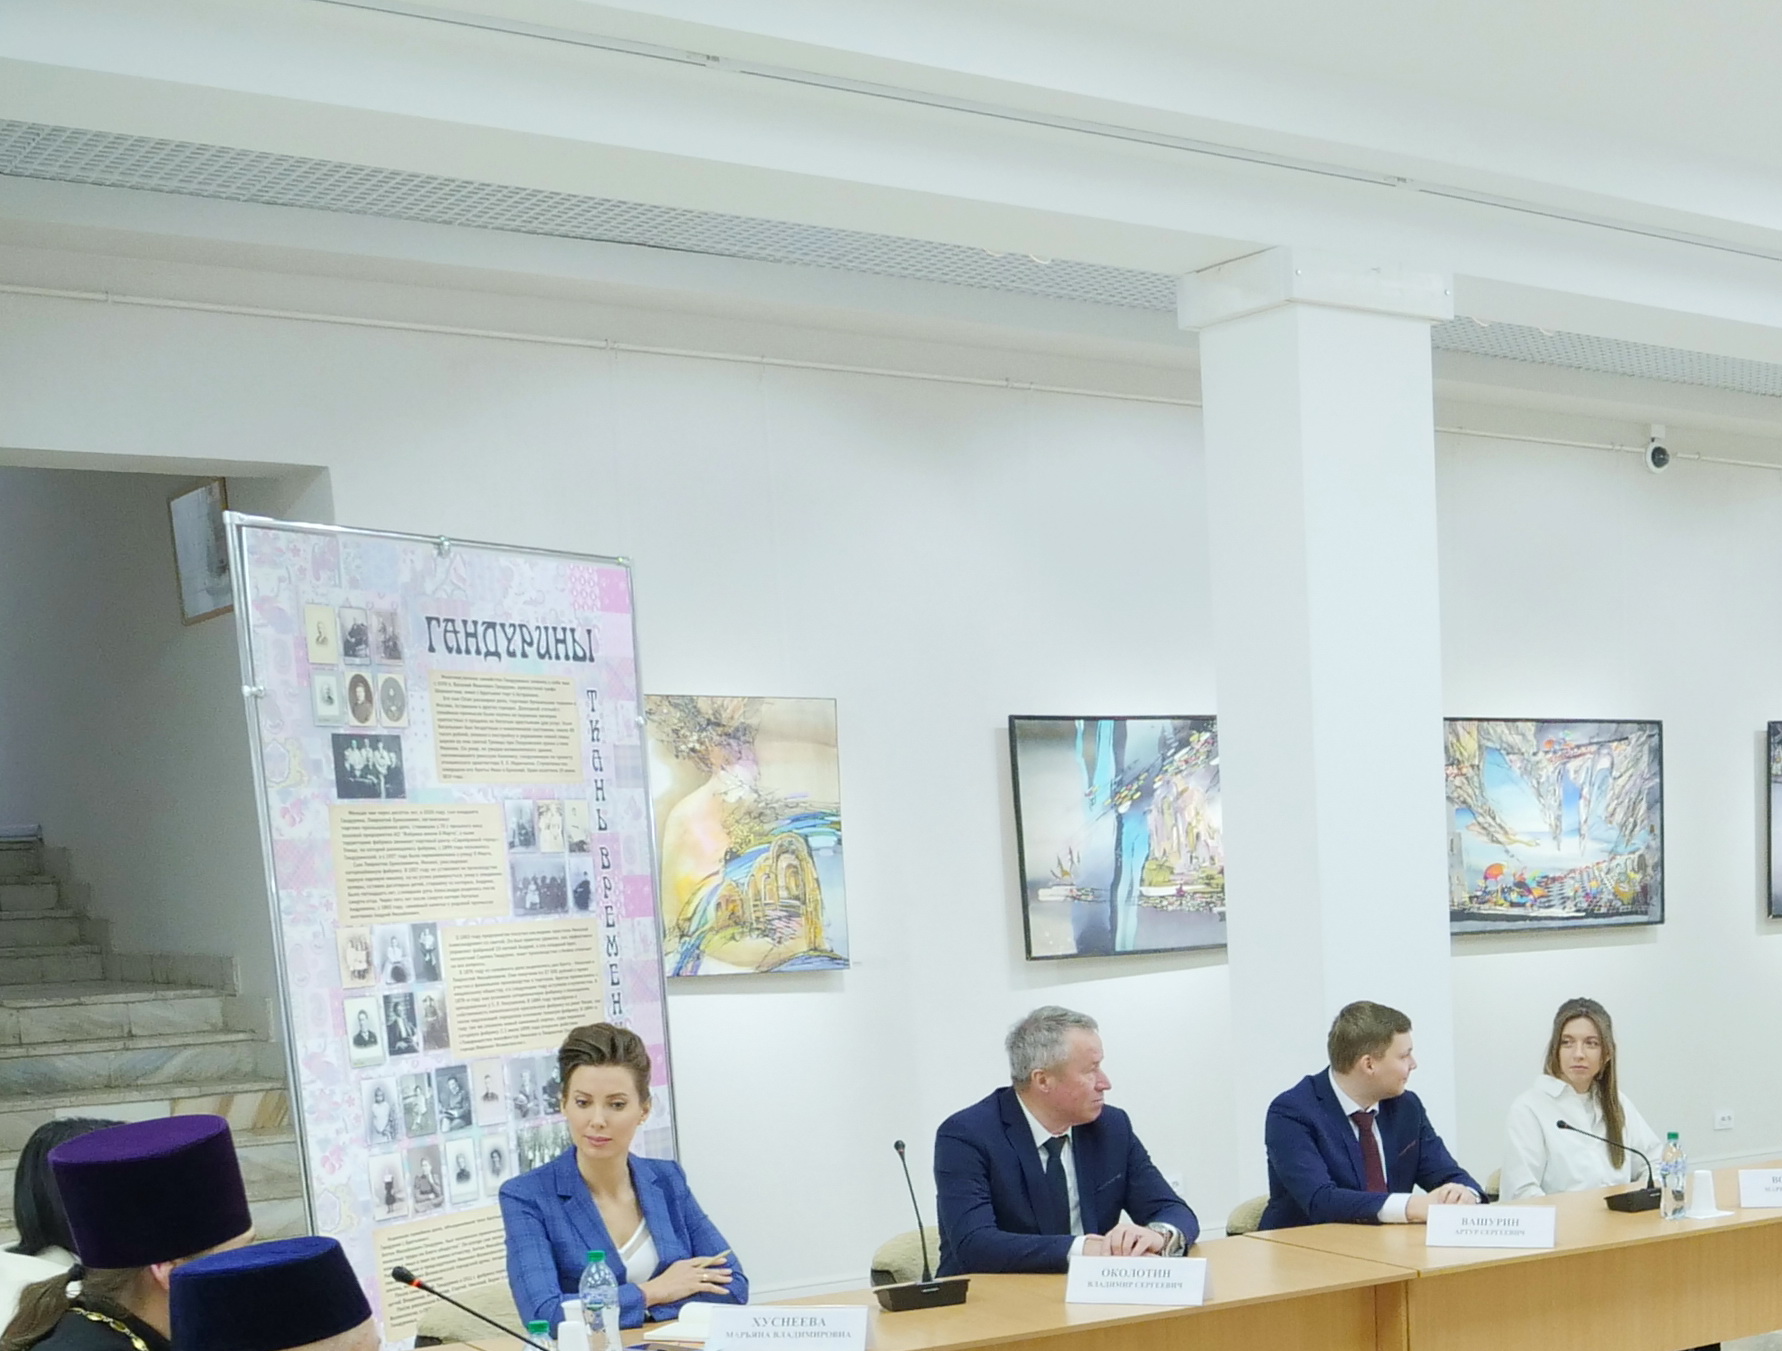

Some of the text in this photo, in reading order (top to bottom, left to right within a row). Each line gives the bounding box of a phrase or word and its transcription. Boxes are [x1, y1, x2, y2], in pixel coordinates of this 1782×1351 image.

[425, 616, 596, 663] ГАНДУРИНЫ
[586, 690, 624, 1027] ТКАНЬ ВРЕМЕН
[1461, 1217, 1521, 1227] ВАШУРИН
[1101, 1268, 1172, 1278] ОКОЛОТИН
[752, 1317, 827, 1328] ХУСНЕЕВА
